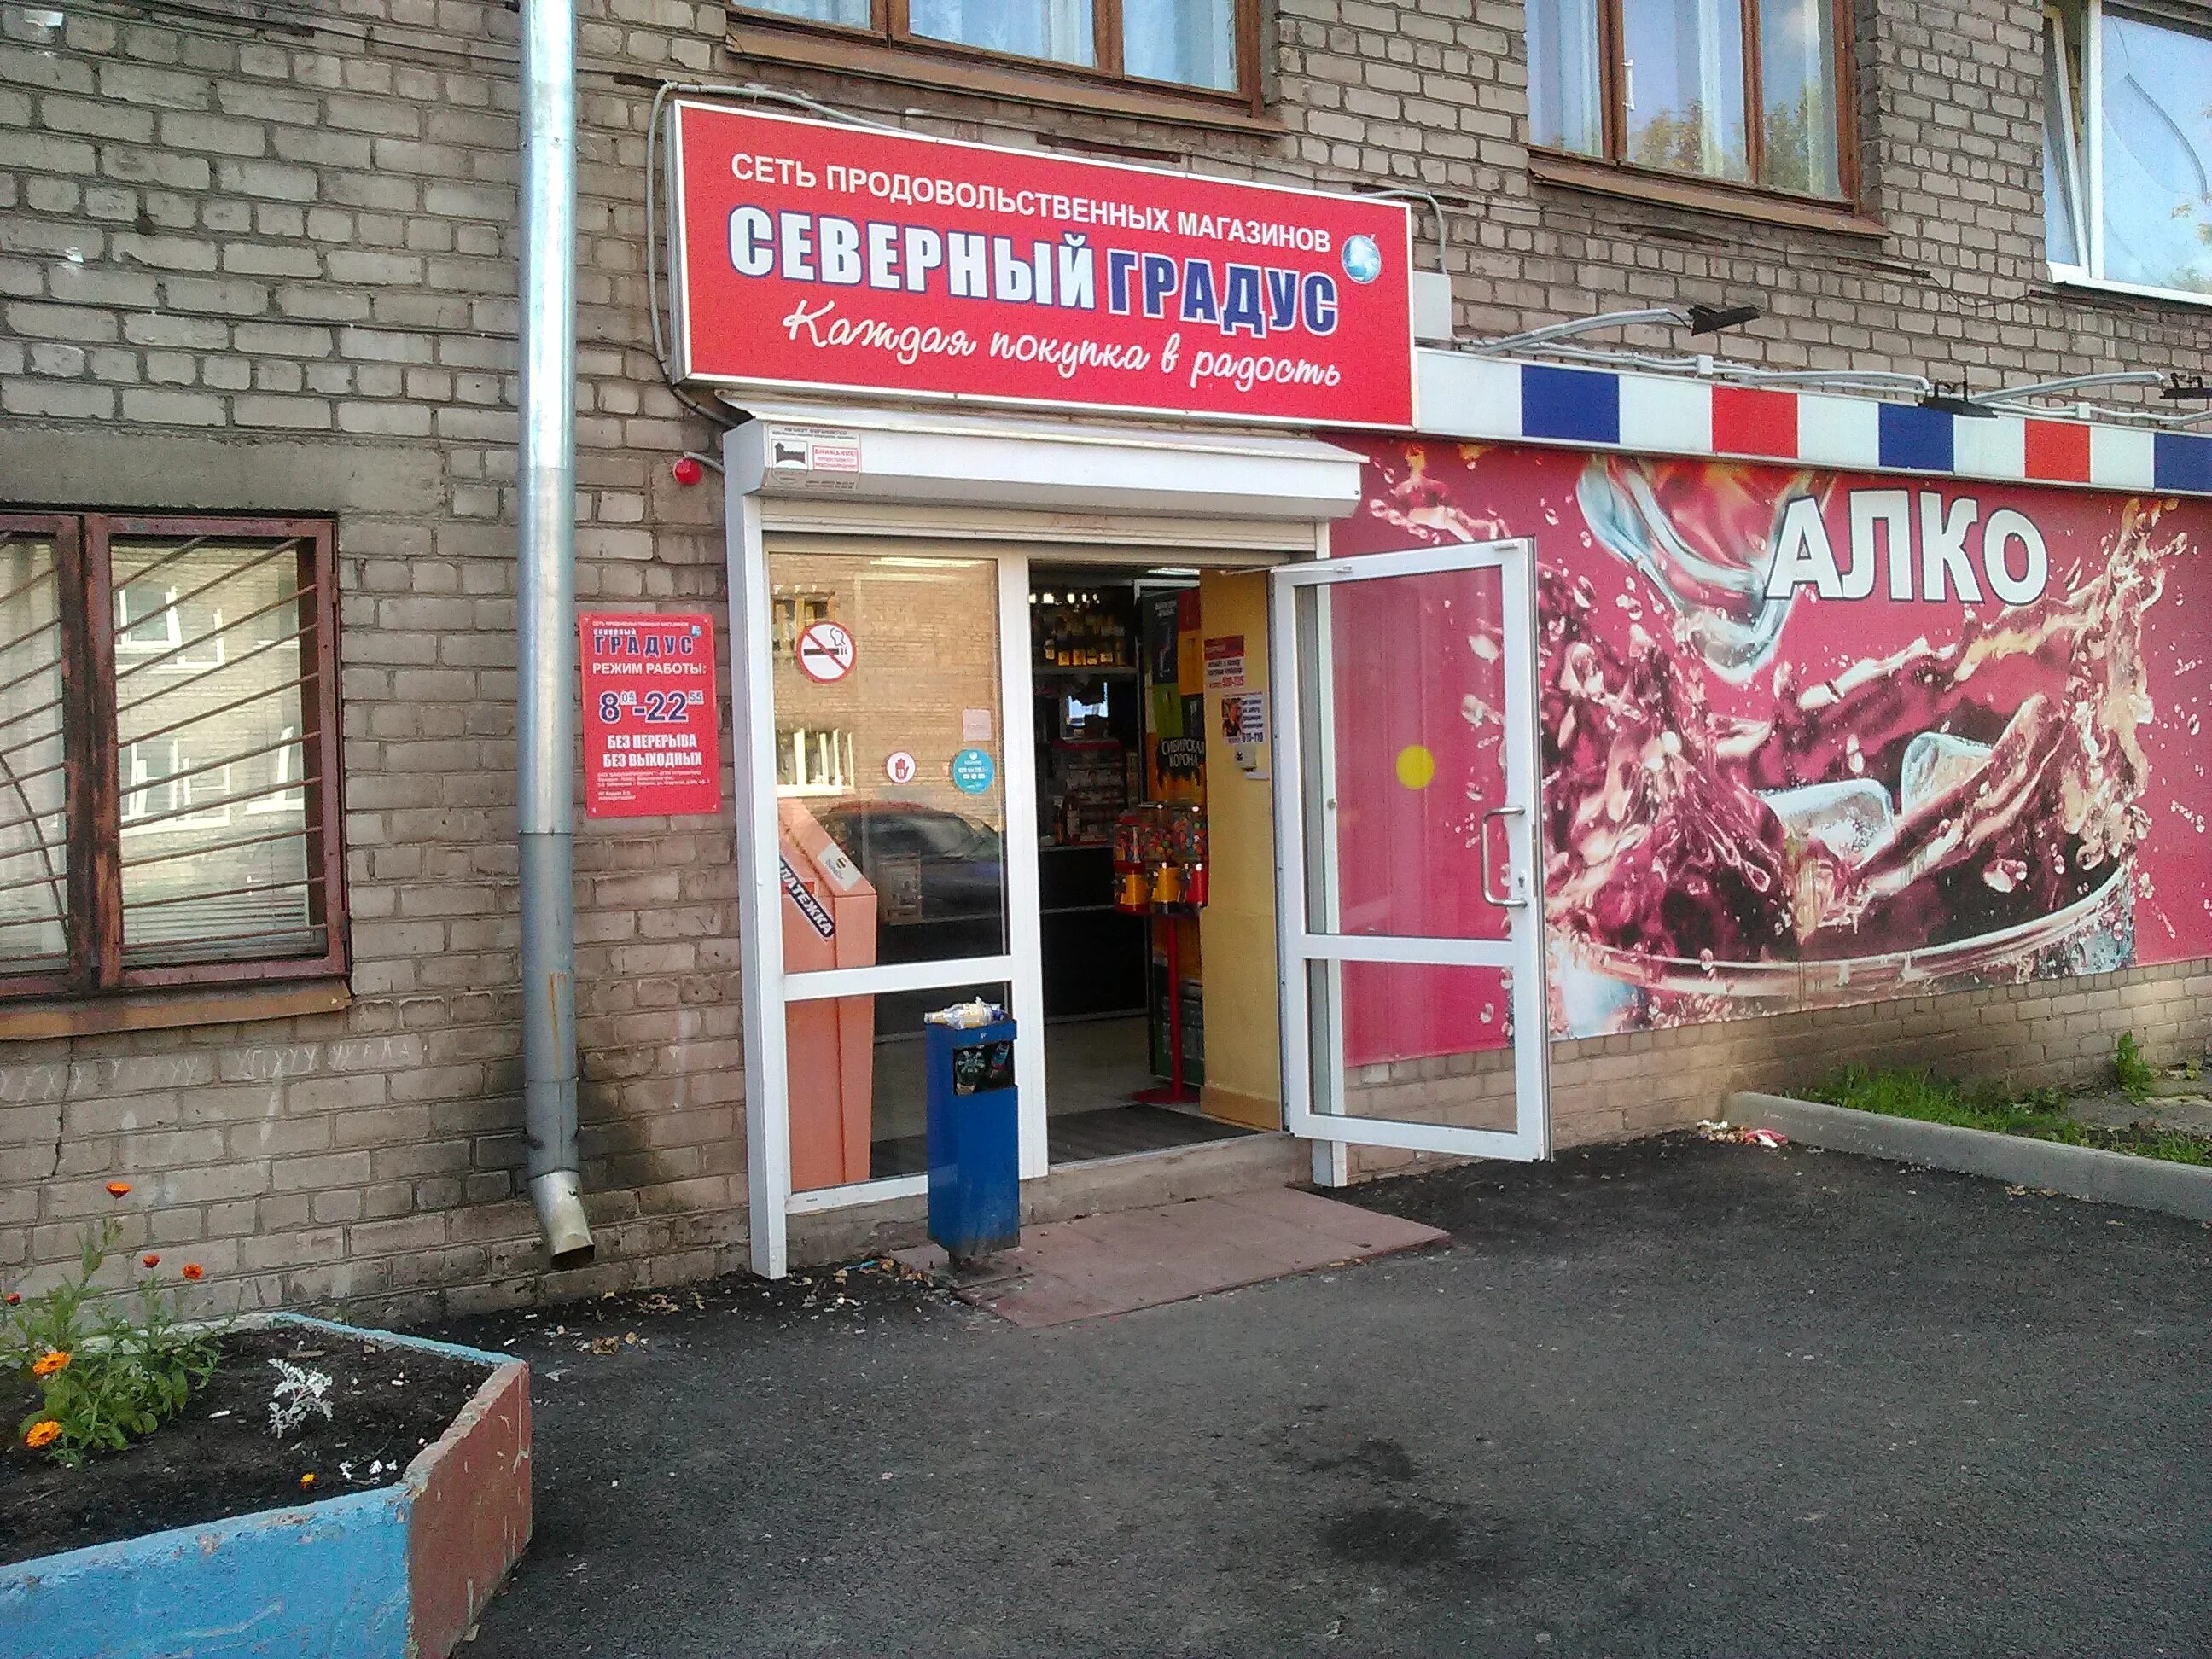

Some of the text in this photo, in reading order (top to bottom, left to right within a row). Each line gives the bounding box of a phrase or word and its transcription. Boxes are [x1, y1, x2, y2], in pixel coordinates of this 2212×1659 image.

[731, 153, 1330, 253] СЕТЬ ПРОДОВОЛЬСТВЕННЫХ МАГАЗИНОВ
[727, 203, 1339, 339] СЕВЕРНЫЙ ГРАДУС
[782, 299, 1342, 393] Каждая покупка в радость
[1765, 487, 2048, 606] АЛКО
[592, 661, 707, 676] РЕЖИМ РАБОТЫ:
[594, 635, 694, 659] ГРАДУС
[602, 751, 702, 768] БЕЗ ВЫХОДНЫХ
[607, 733, 698, 749] БЕЗ ПЕРЕРЫВА
